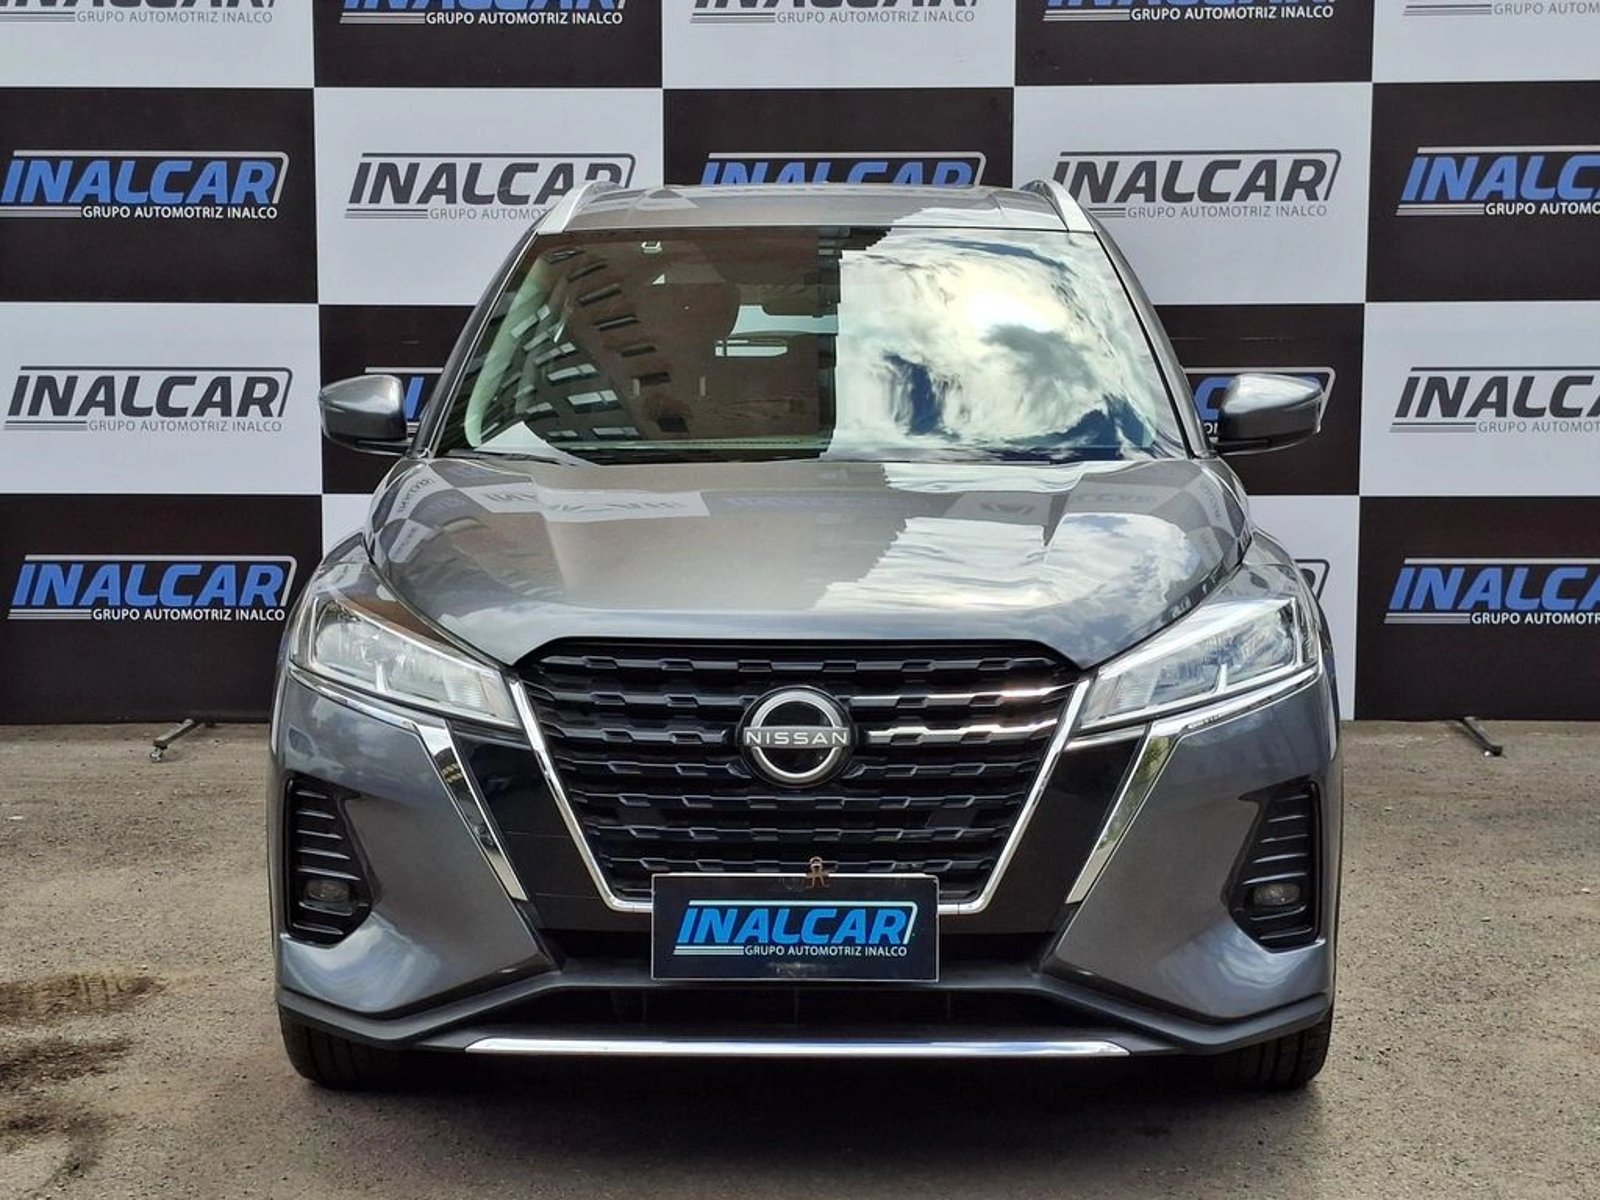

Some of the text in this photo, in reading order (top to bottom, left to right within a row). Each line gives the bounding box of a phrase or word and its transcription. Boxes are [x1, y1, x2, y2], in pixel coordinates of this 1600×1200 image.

[1131, 6, 1334, 21] GRUPO AUTOMOTRIZ INALCO
[1493, 3, 1544, 15] GRUPO
[77, 11, 273, 23] GRUPO AUTOMOTRIZ INALCO
[426, 12, 623, 25] GRUPO AUTOMOTRIZ INALCO
[777, 10, 975, 23] GRUPO AUTOMOTRIZ INALCO
[1, 160, 276, 203] INALCAR
[1401, 155, 1600, 200] INALC
[82, 206, 278, 219] GRUPO AUTOMOTRIZ INALCO
[429, 208, 477, 220] GRUPO
[1127, 204, 1328, 218] GRUPO AUTOMOTRIZ INALCO
[1485, 203, 1536, 215] GRUPO
[7, 375, 280, 418] INALCAR
[1395, 375, 1600, 418] INALC
[88, 420, 283, 432] GRUPO AUTOMOTRIZ INALCO
[1478, 421, 1527, 433] GRUPO
[12, 564, 284, 607] INALCAR
[93, 608, 286, 621] GRUPO AUTOMOTRIZ INALCO
[1471, 612, 1520, 624] GRUPO
[746, 731, 848, 745] NISSAN
[677, 908, 907, 944] INALCAR
[744, 945, 908, 958] GRUPO AUTOMOTRIZ INALCO
